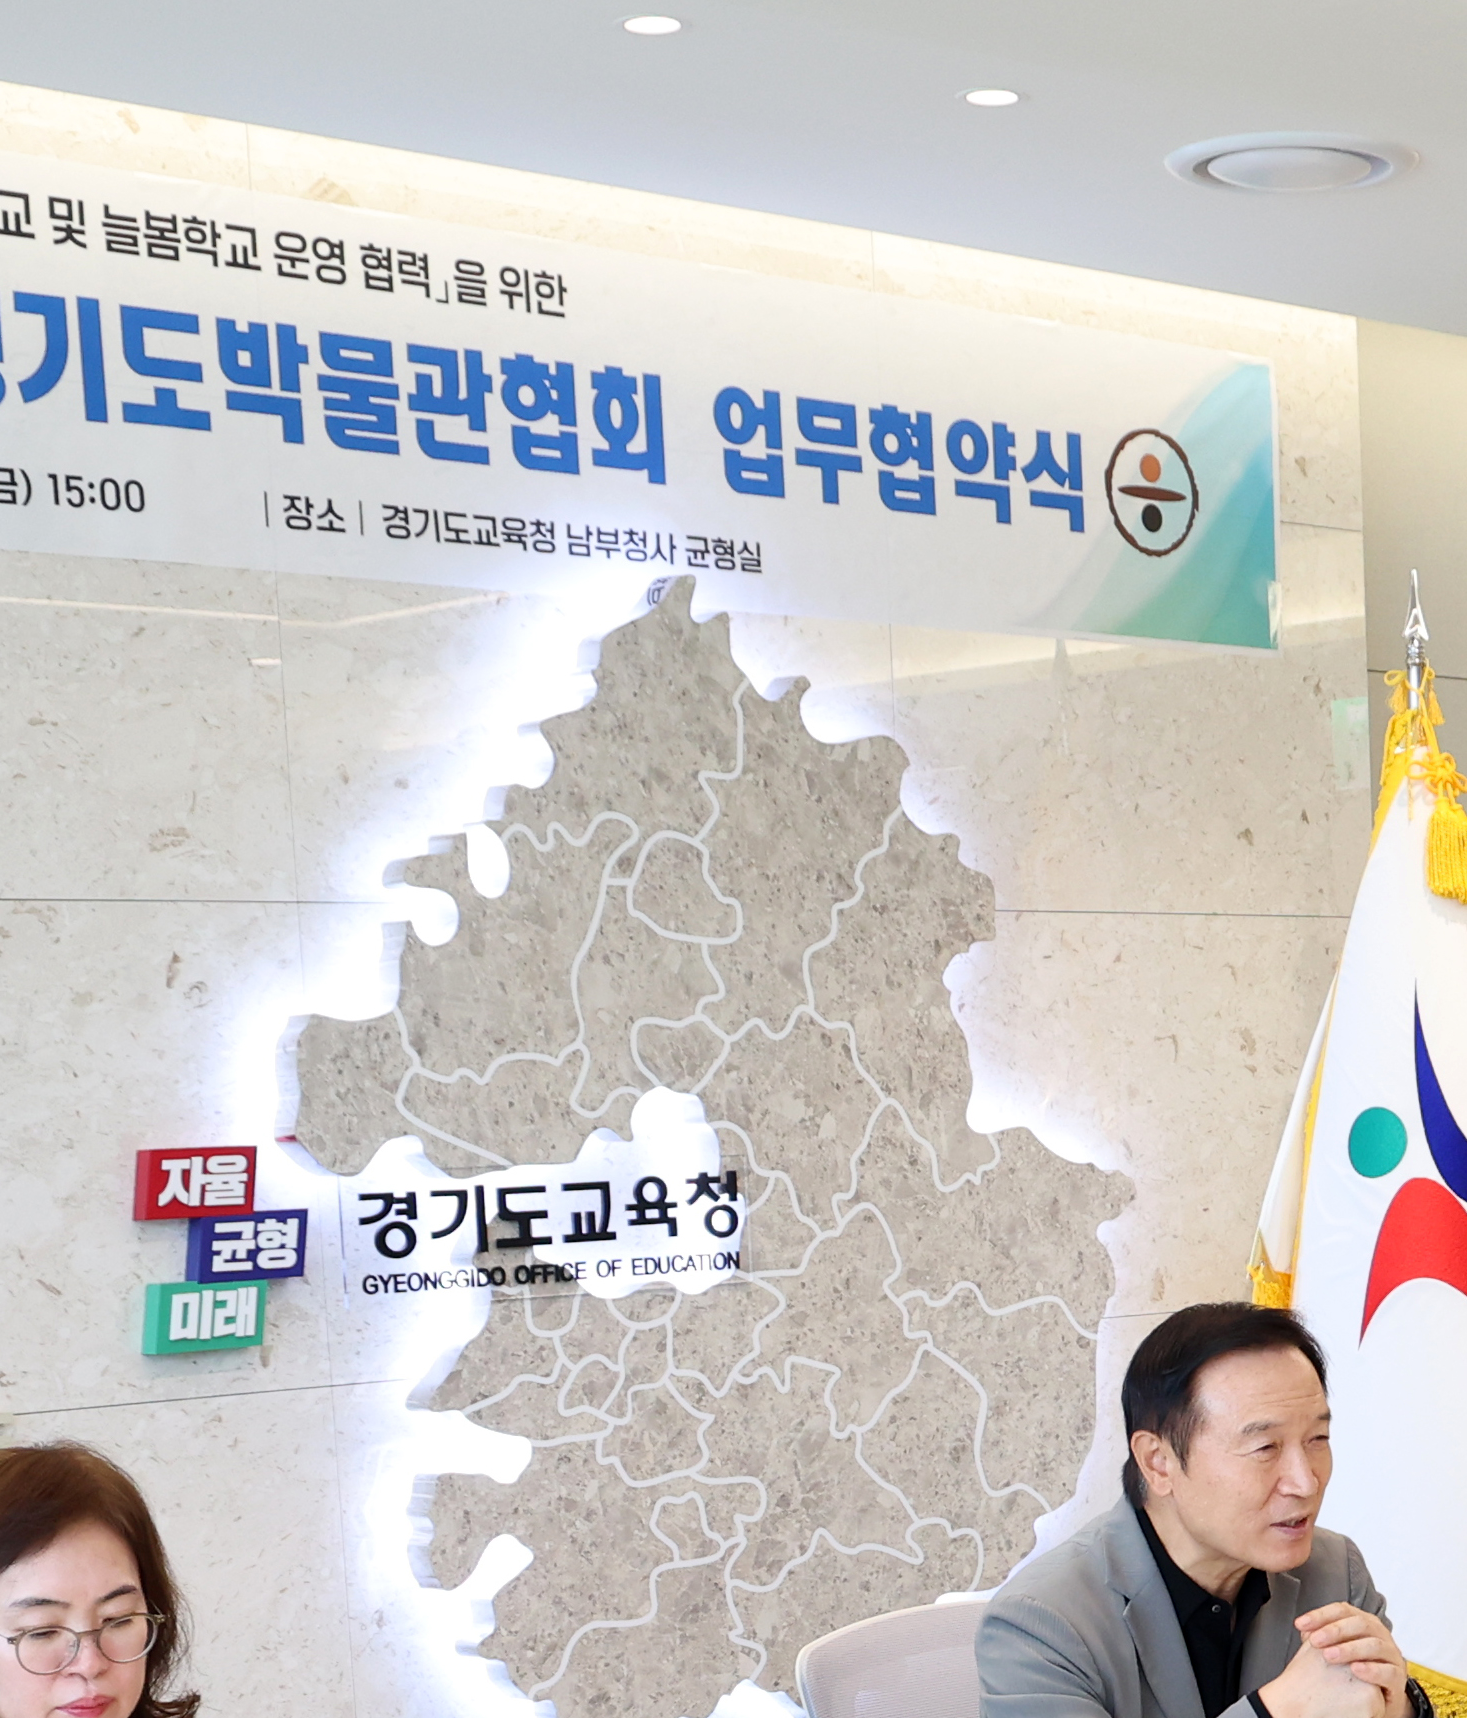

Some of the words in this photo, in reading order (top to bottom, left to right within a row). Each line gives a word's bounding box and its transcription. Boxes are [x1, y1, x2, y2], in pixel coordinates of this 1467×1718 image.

[47, 195, 88, 249] 및
[101, 203, 262, 272] 늘봄학교
[273, 230, 347, 286] 운영
[499, 267, 568, 318] 위한
[713, 384, 1088, 535] 업무협약식
[47, 472, 146, 514] 15:00
[282, 494, 346, 535] 장소
[381, 503, 557, 556] 경기도교육청
[566, 521, 677, 567] 남부청사
[684, 534, 764, 576] 균형실
[158, 1153, 248, 1209] 자율
[358, 1170, 739, 1259] 경기도교육청
[210, 1217, 299, 1273] 균형
[362, 1266, 505, 1296] GYEONGGIDO
[515, 1261, 587, 1286] OFFICE
[596, 1258, 622, 1279] OF
[631, 1250, 740, 1277] EDUCATION
[169, 1284, 258, 1342] 미래
